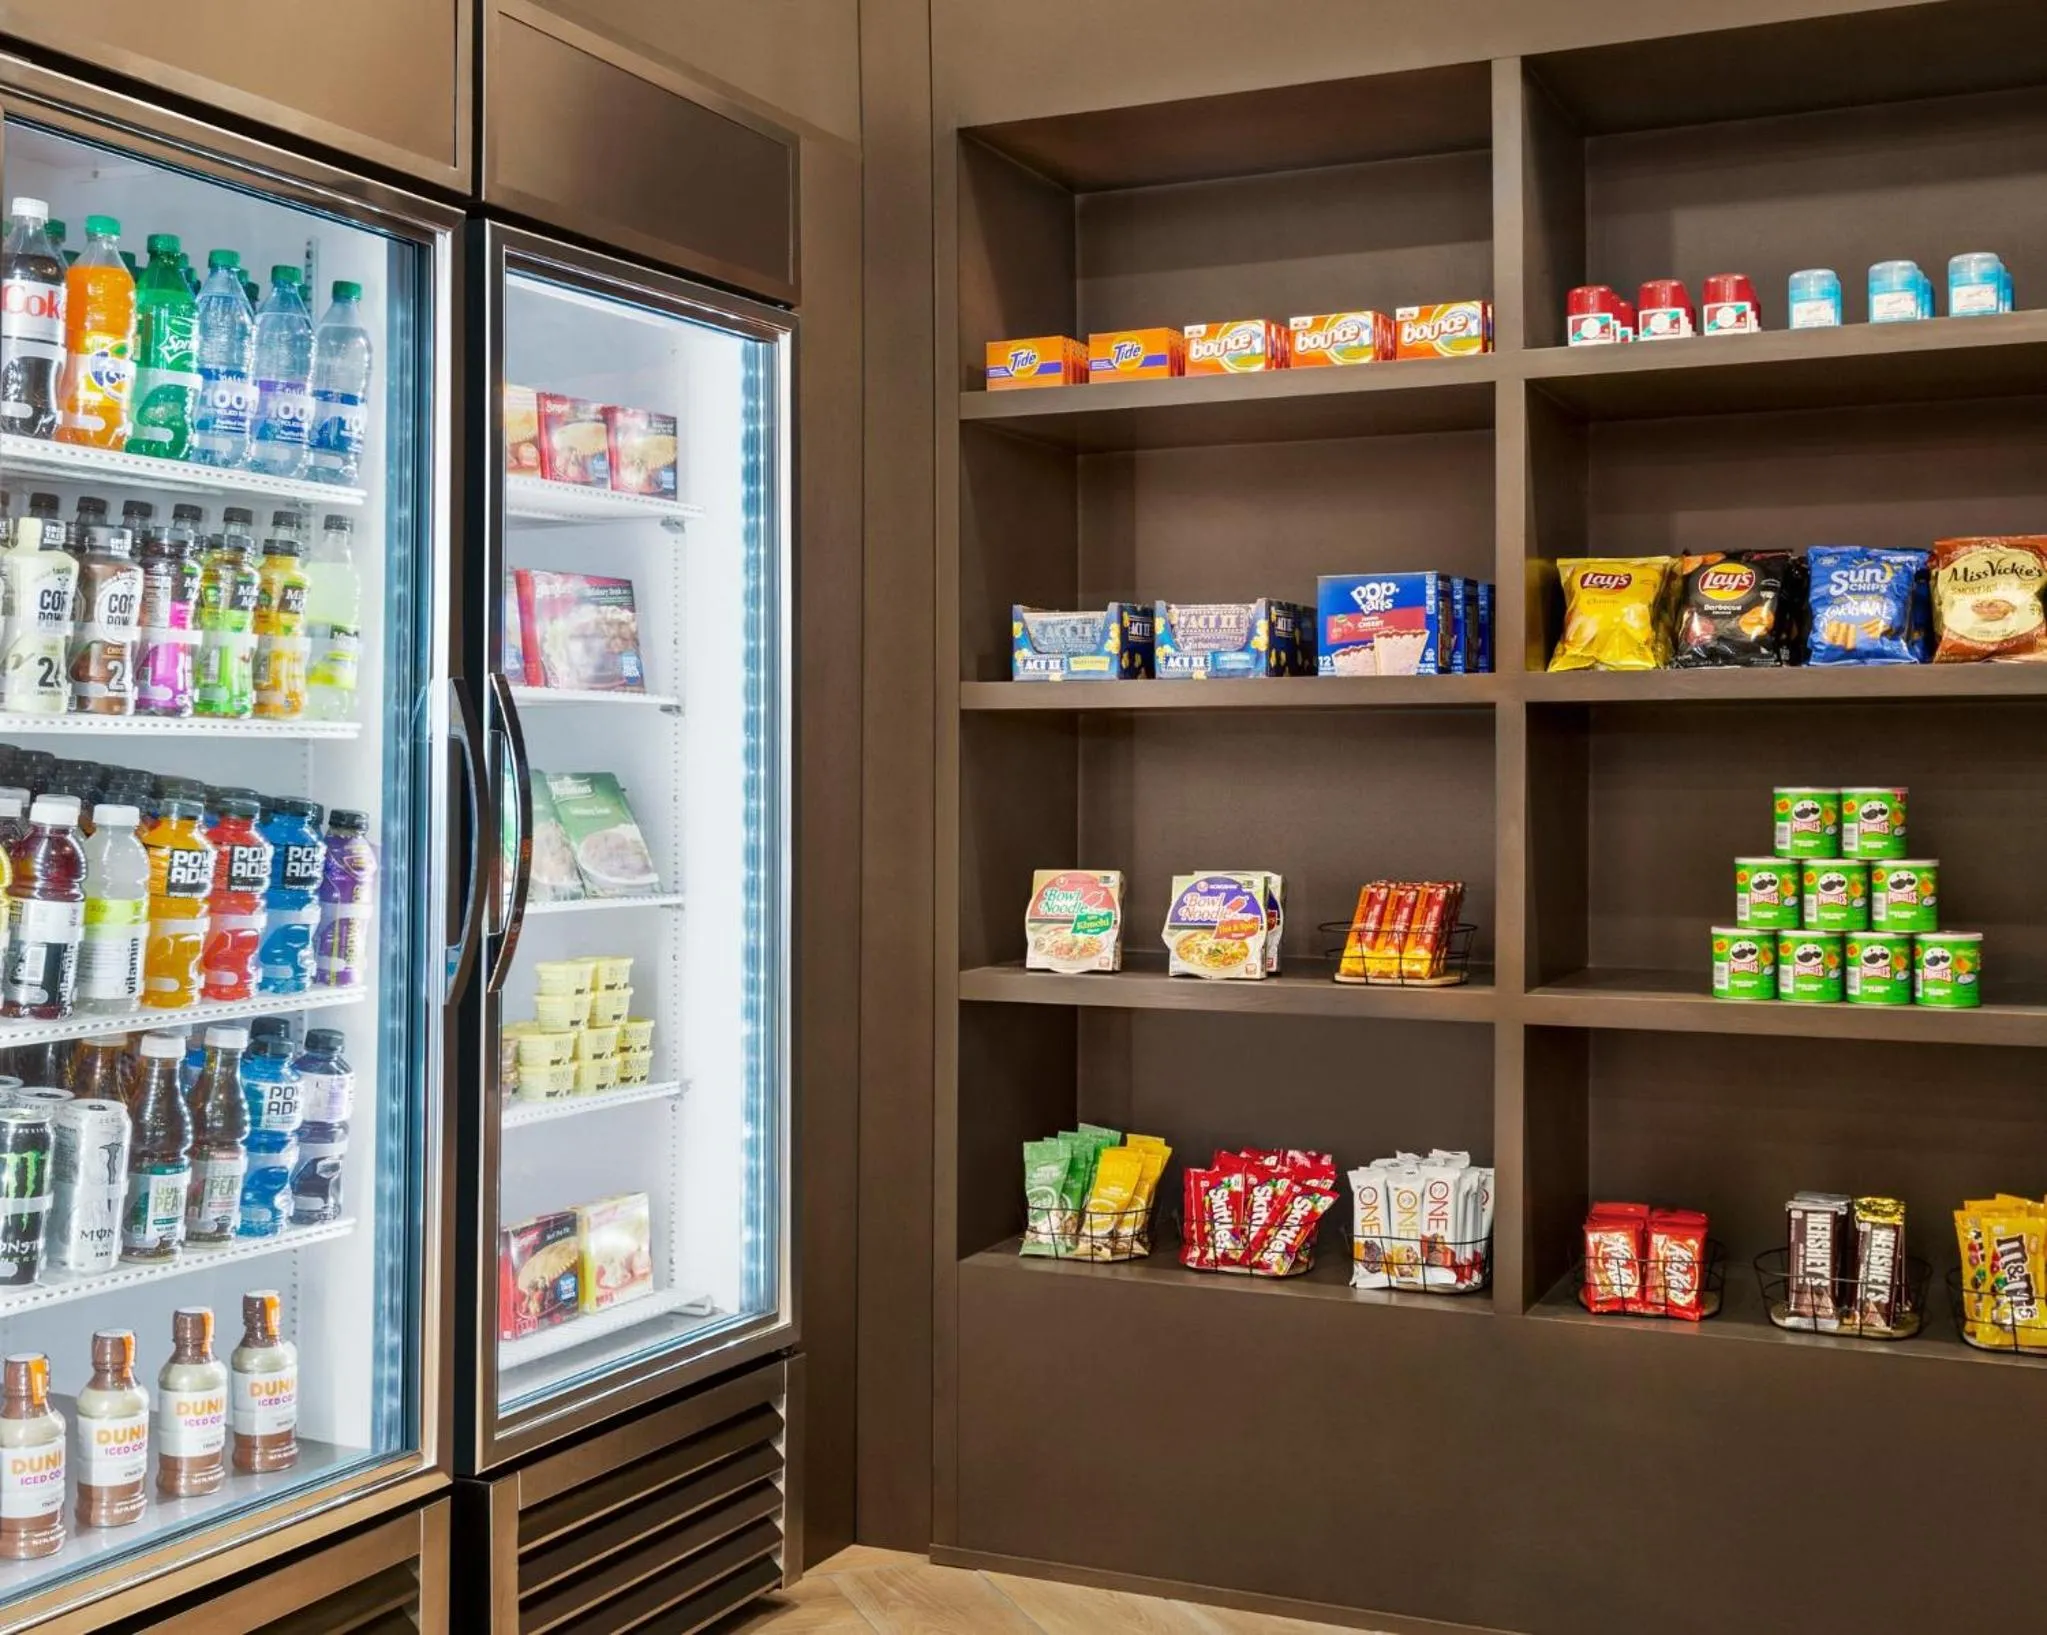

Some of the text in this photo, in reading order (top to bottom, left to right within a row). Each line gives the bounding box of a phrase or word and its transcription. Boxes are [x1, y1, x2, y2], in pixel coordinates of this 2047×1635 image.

[1296, 323, 1361, 352] bounce
[1403, 314, 1469, 344] bounce
[1114, 342, 1141, 363] Tide
[1190, 331, 1253, 361] bounce
[1011, 350, 1037, 371] Tide
[1703, 571, 1752, 590] Lay's
[1948, 557, 2043, 583] Miss Vickie's
[1583, 573, 1631, 590] Lay's
[1829, 567, 1892, 596] Sun
[1848, 583, 1888, 593] CHIPS
[1025, 659, 1046, 671] ACT
[1167, 656, 1190, 668] ACT
[1317, 656, 1332, 667] 12
[1183, 892, 1227, 907] Bowl
[125, 938, 140, 995] vitamin
[1358, 1185, 1381, 1236] ONE
[1397, 1189, 1418, 1238] ONE
[1428, 1181, 1450, 1232] ONE
[105, 1445, 130, 1455] ICED
[20, 1474, 47, 1486] ICED
